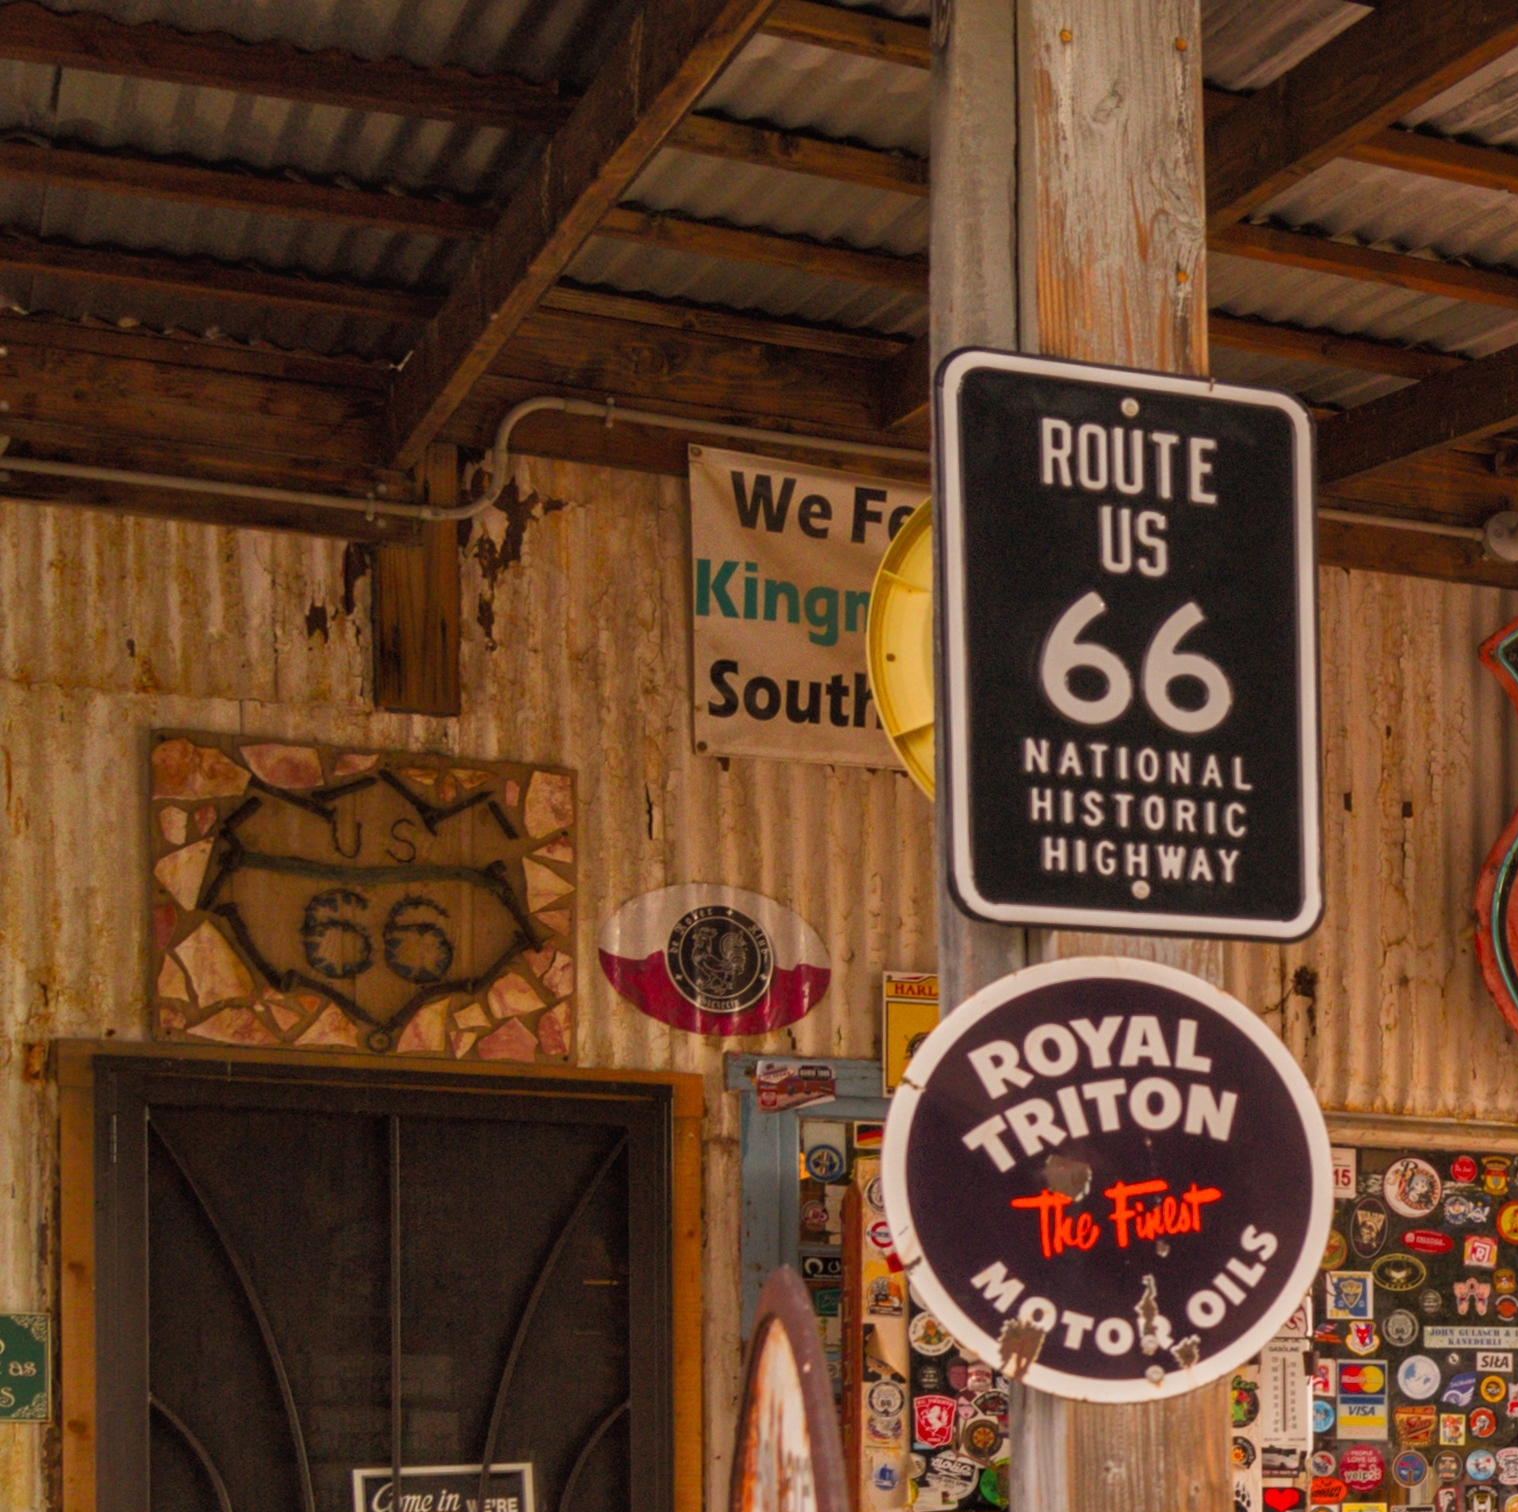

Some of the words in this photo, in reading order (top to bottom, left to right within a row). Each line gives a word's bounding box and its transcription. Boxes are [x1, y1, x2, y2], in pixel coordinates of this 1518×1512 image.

[1039, 417, 1218, 504] ROUTE
[730, 470, 833, 540] We
[1100, 505, 1168, 577] US
[1039, 591, 1233, 733] 66
[1023, 737, 1253, 792] NATIONAL
[1029, 787, 1248, 839] HISTORIC
[1041, 836, 1241, 884] HIGHWAY
[302, 888, 455, 985] 66
[967, 1015, 1213, 1100] ROYAL
[961, 1076, 1238, 1174] TRITON
[1011, 1189, 1099, 1259] The
[1104, 1178, 1223, 1249] Finest
[970, 1260, 1175, 1357] MOTOR
[1186, 1223, 1280, 1330] OILS
[1348, 1406, 1376, 1416] VISA
[437, 1488, 461, 1512] in
[1345, 1471, 1370, 1482] yelp
